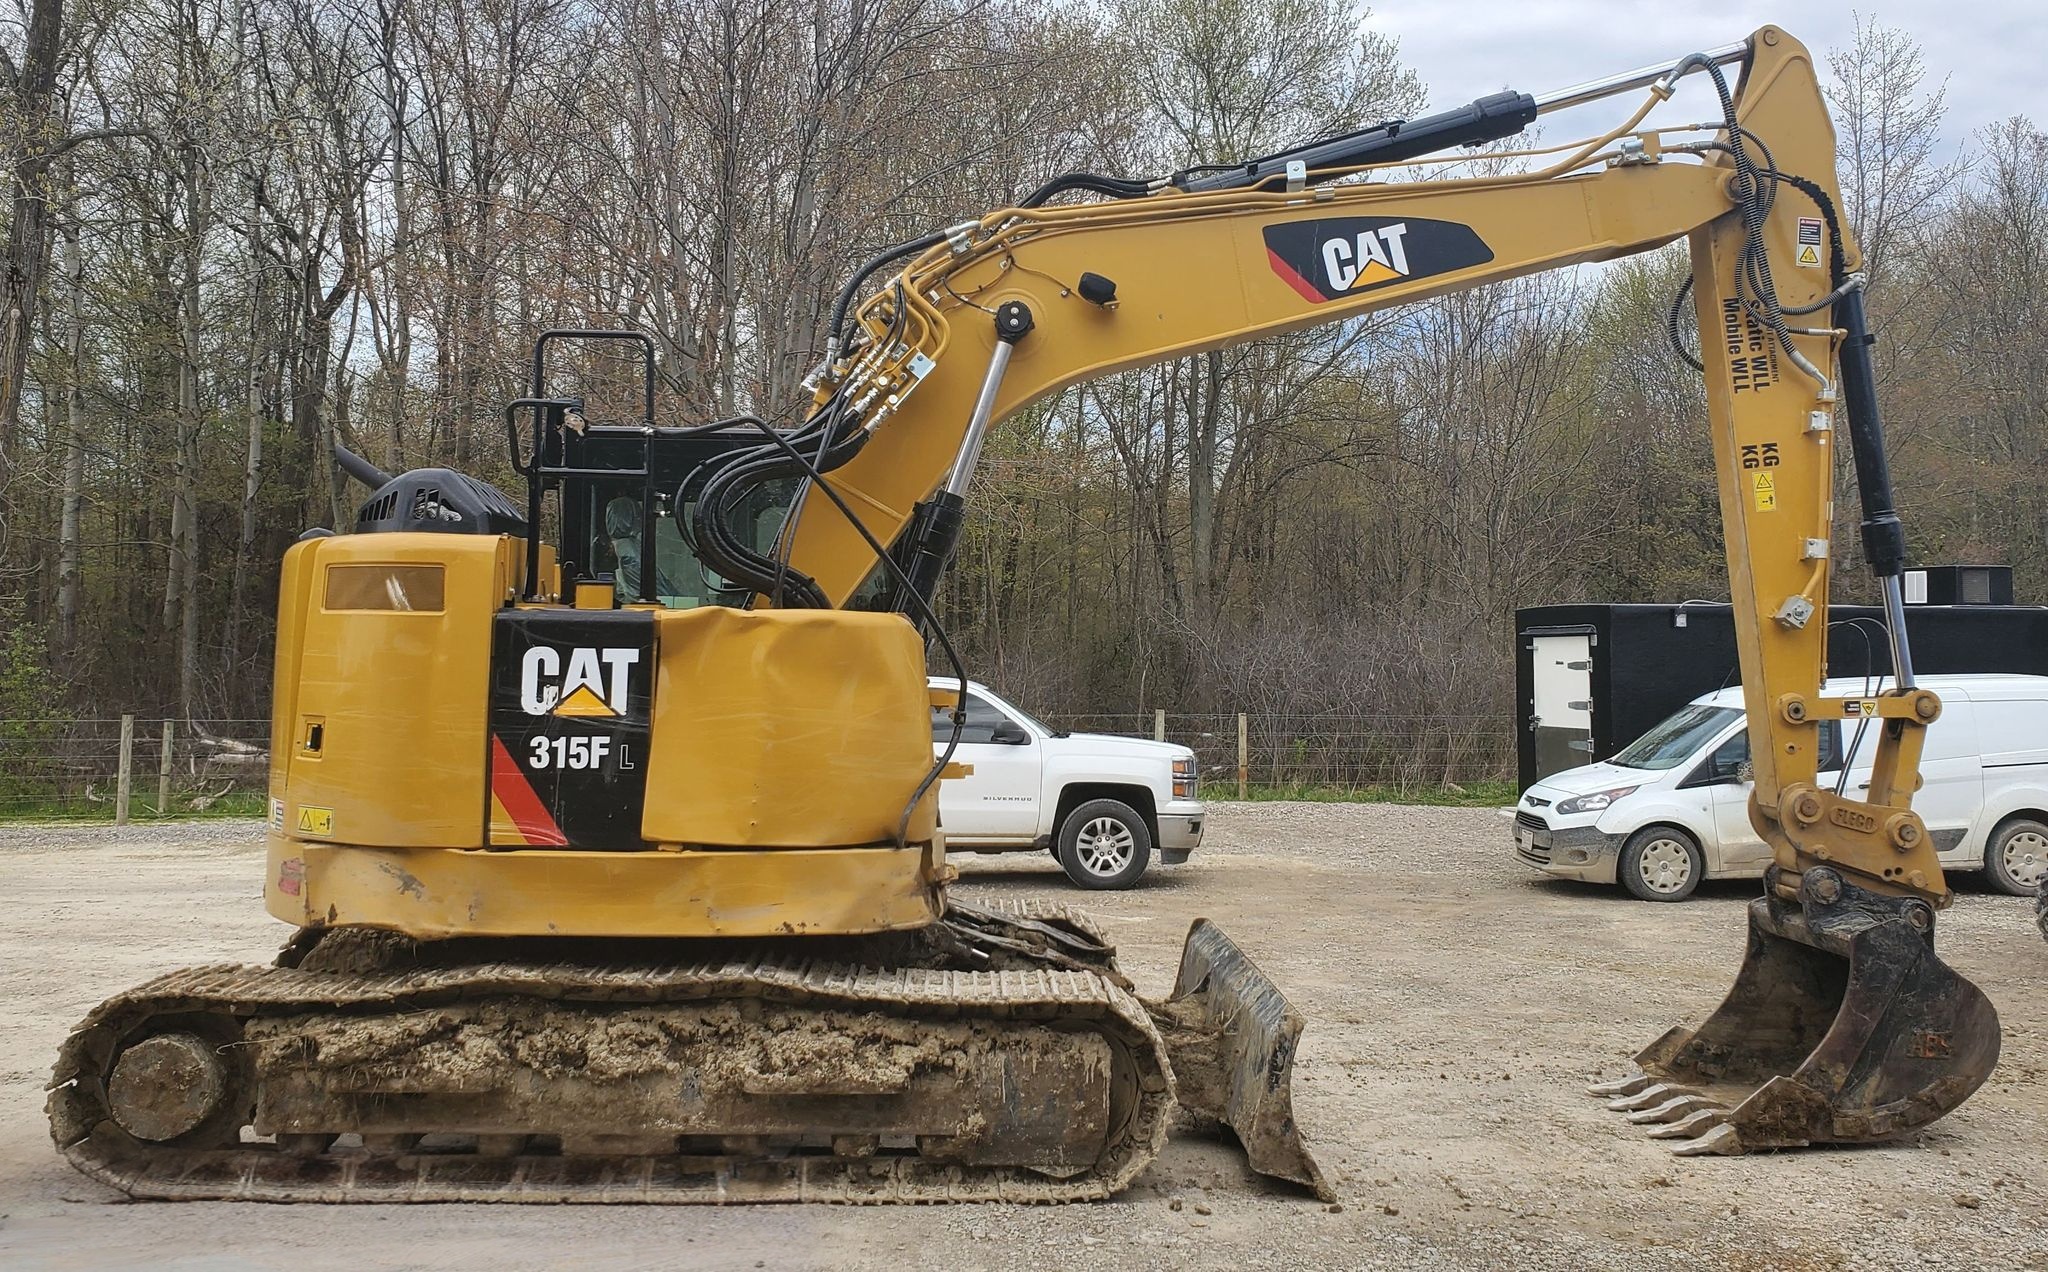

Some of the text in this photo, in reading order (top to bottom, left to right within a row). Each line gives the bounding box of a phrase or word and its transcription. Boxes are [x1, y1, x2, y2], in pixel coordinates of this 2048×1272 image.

[1322, 222, 1410, 291] CAT
[1723, 298, 1750, 394] Mobile WLL
[1746, 300, 1765, 352] Satic
[1751, 355, 1770, 393] WLL
[1767, 337, 1780, 383] ATTACHMENT
[1741, 444, 1760, 469] KG
[1761, 442, 1780, 467] KG
[521, 645, 639, 716] CAT
[529, 735, 635, 770] 315F L
